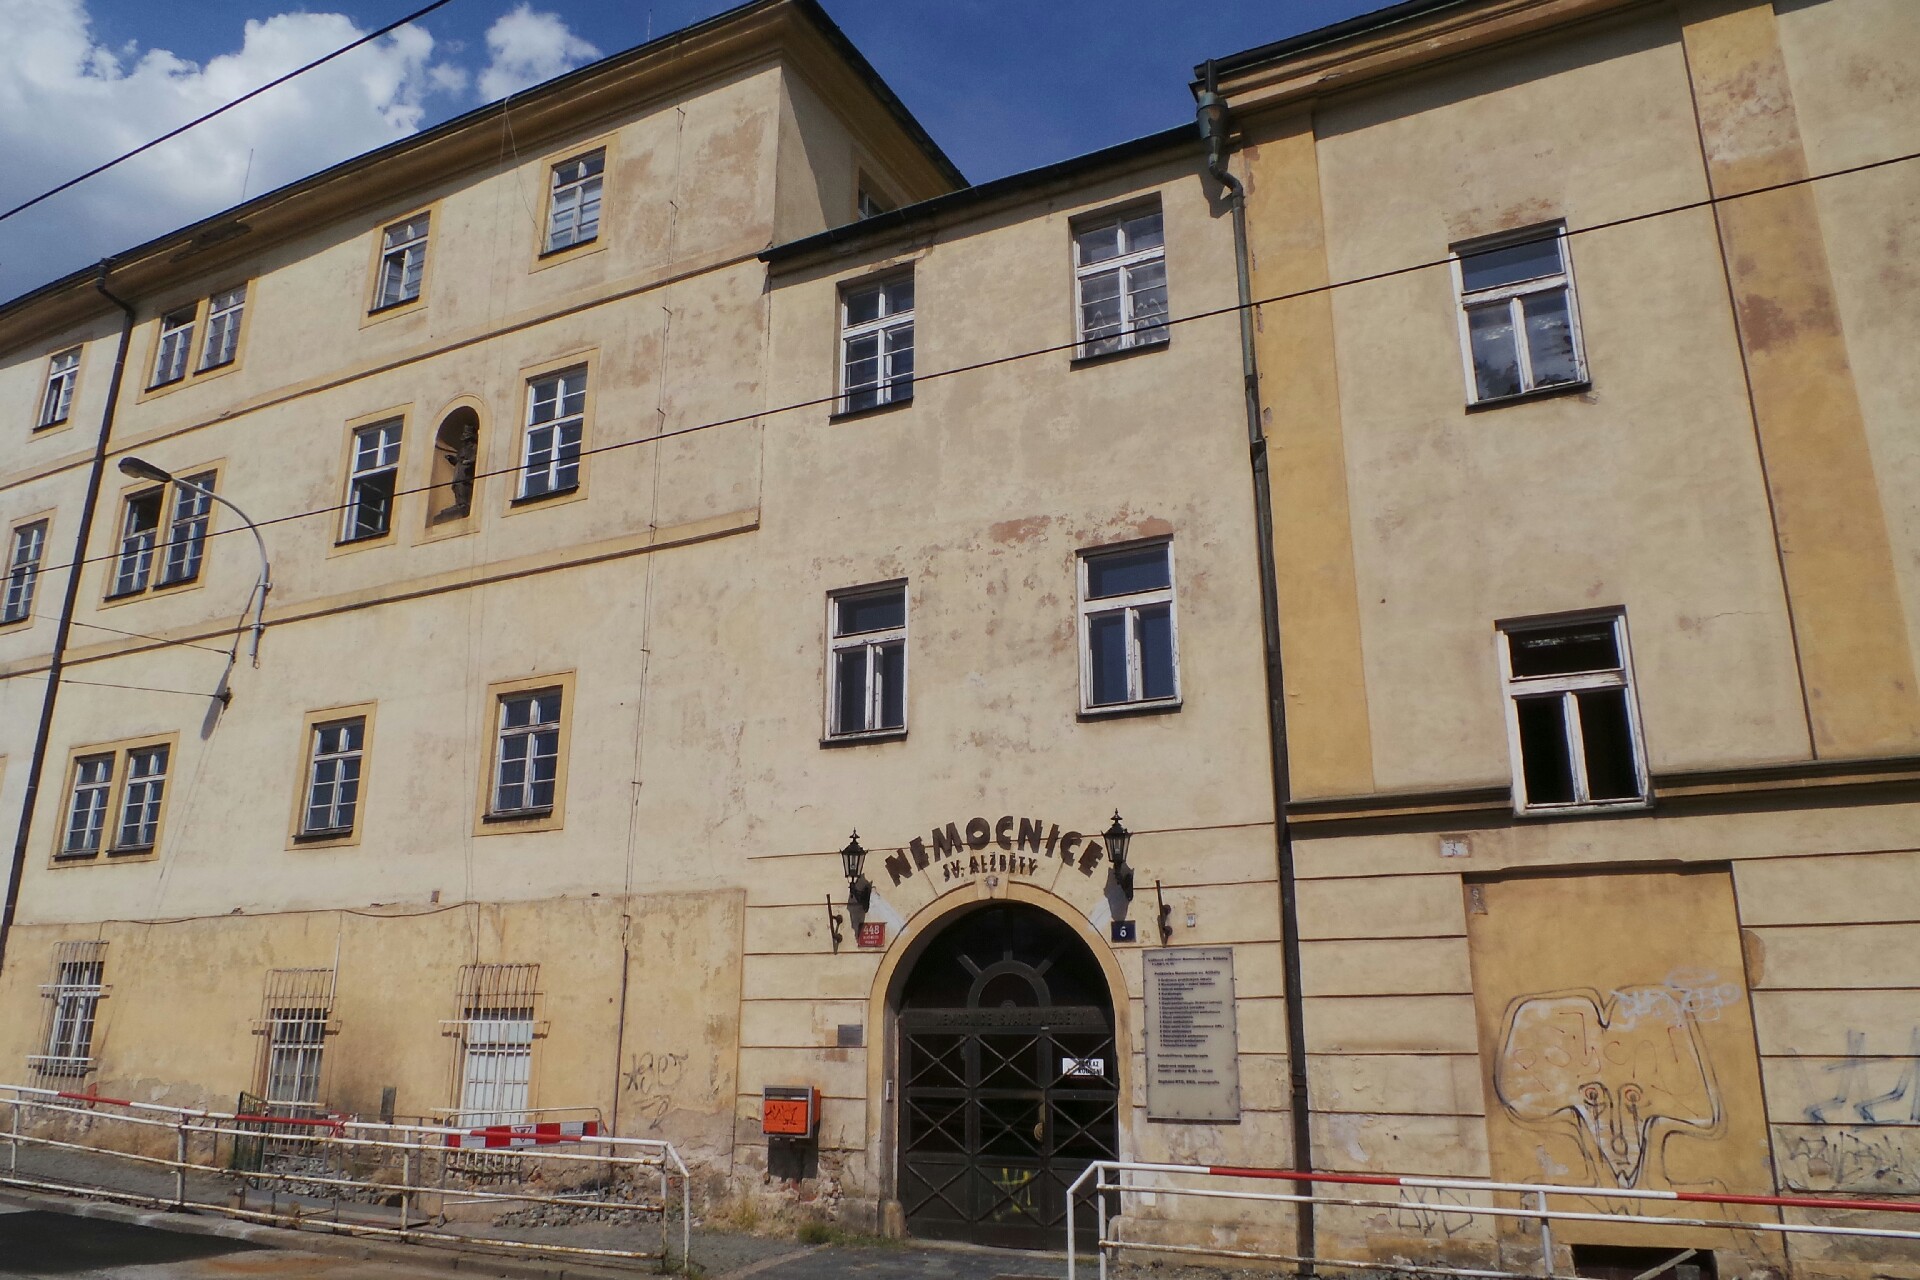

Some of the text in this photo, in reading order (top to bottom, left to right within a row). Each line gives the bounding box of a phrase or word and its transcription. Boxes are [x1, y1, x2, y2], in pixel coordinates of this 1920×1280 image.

[885, 815, 1104, 887] NEMOCNICE
[968, 851, 1038, 876] ALŽBĚTY
[863, 924, 880, 935] 448
[1119, 926, 1127, 937] 6
